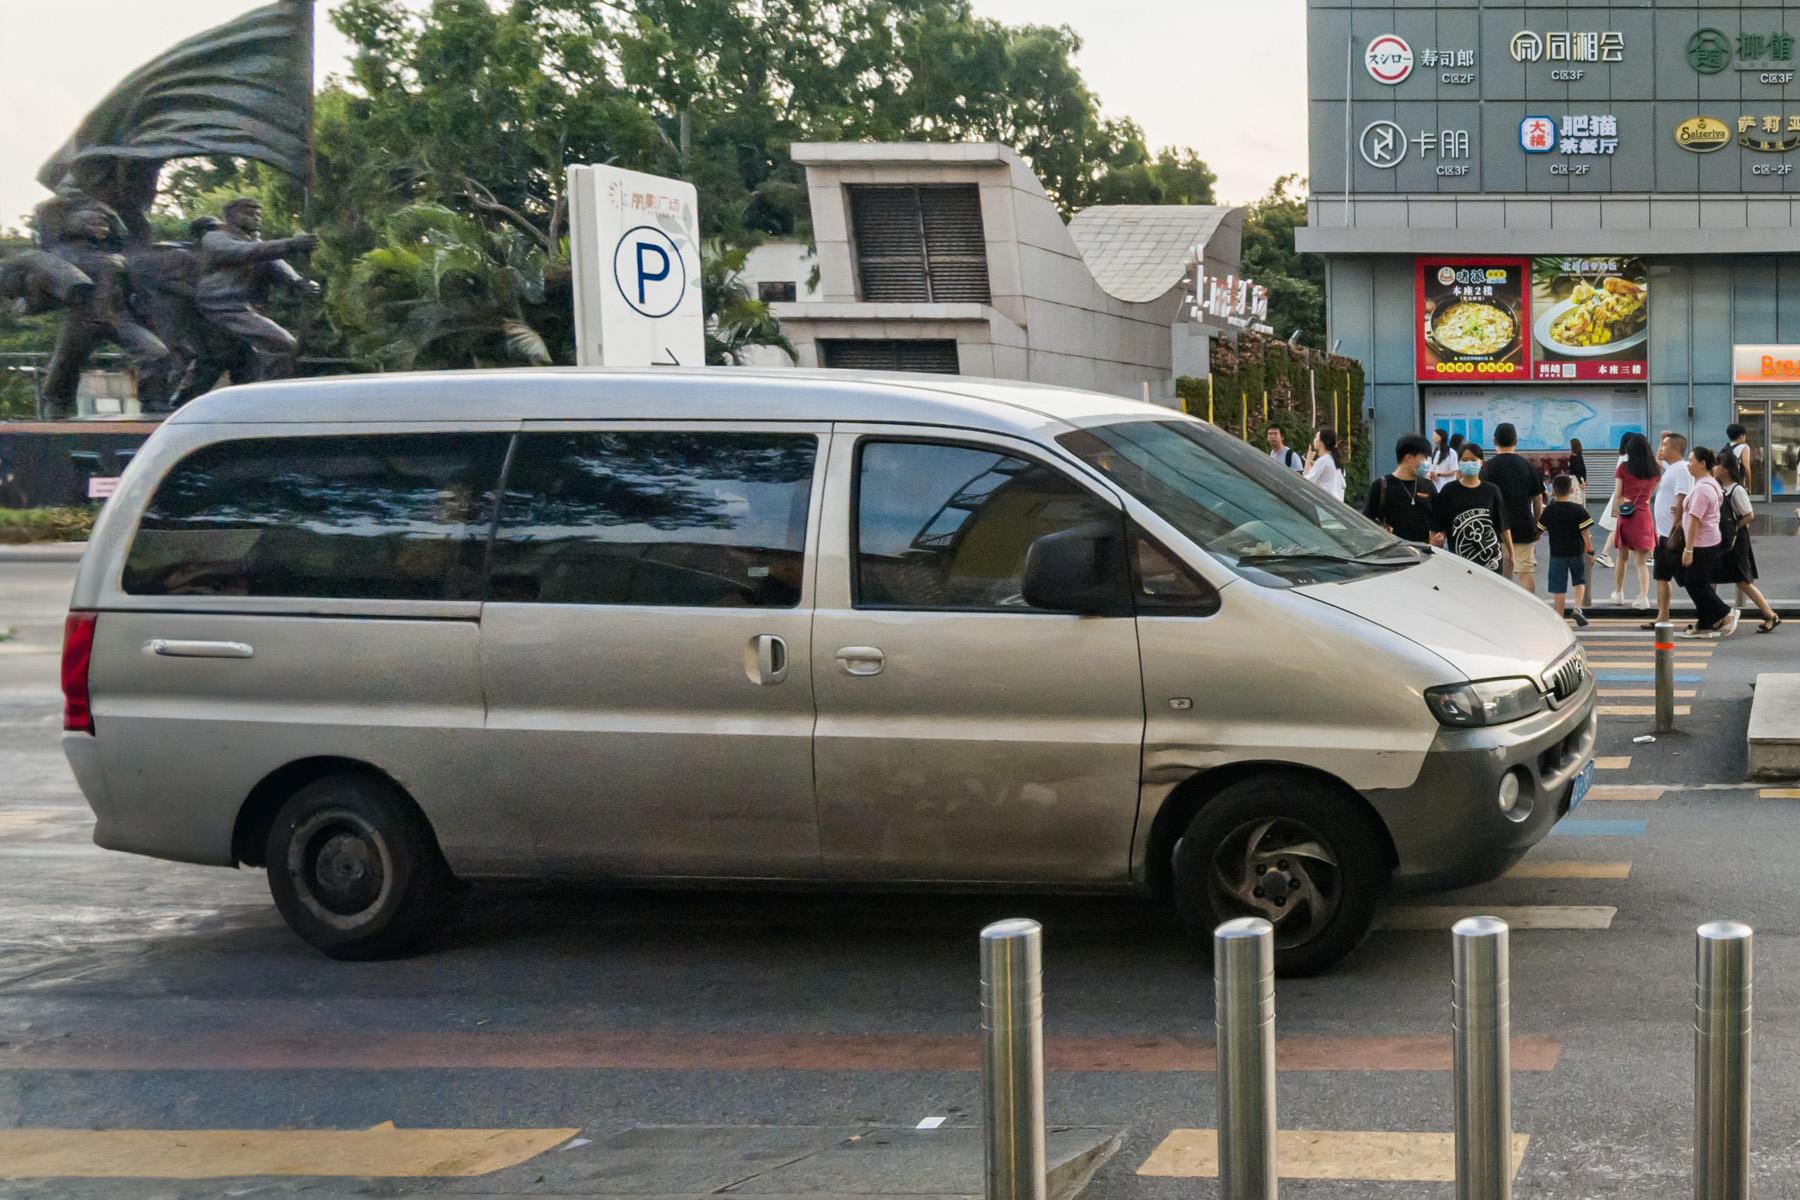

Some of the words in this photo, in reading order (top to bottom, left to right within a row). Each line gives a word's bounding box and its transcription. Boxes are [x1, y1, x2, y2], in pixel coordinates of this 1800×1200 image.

[1369, 53, 1412, 65] スシロー
[1421, 49, 1474, 67] 寿司郎
[1441, 73, 1475, 84] C区2F
[1551, 70, 1584, 80] C区3F
[1760, 73, 1793, 83] C区3F
[1560, 115, 1617, 137] 肥猫
[1560, 138, 1618, 154] 茶餐厅
[1436, 166, 1469, 176] C区3F
[636, 241, 671, 304] P
